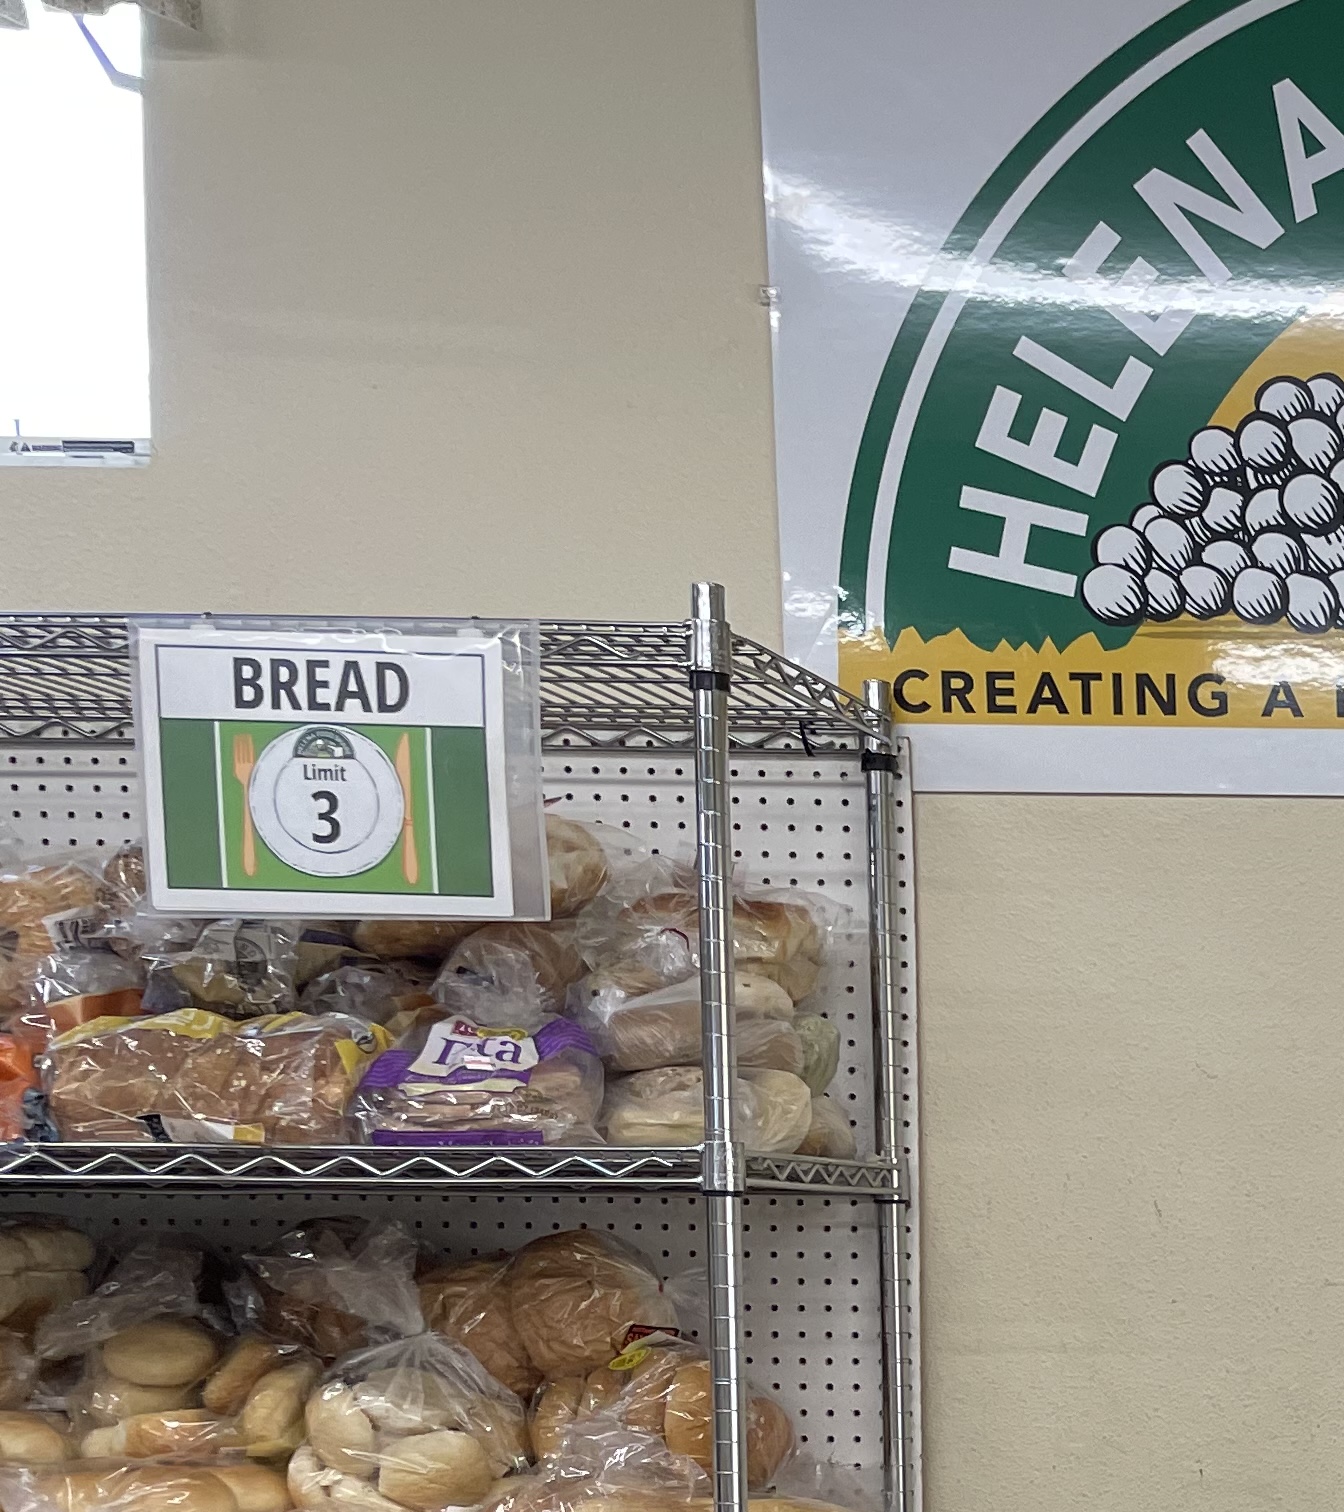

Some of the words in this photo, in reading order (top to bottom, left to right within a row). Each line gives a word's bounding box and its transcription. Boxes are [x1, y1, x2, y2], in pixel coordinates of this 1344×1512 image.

[231, 656, 411, 715] BREAD
[893, 668, 1229, 718] CREATING
[1261, 678, 1304, 718] A
[303, 763, 347, 782] Limit
[311, 789, 342, 845] 3
